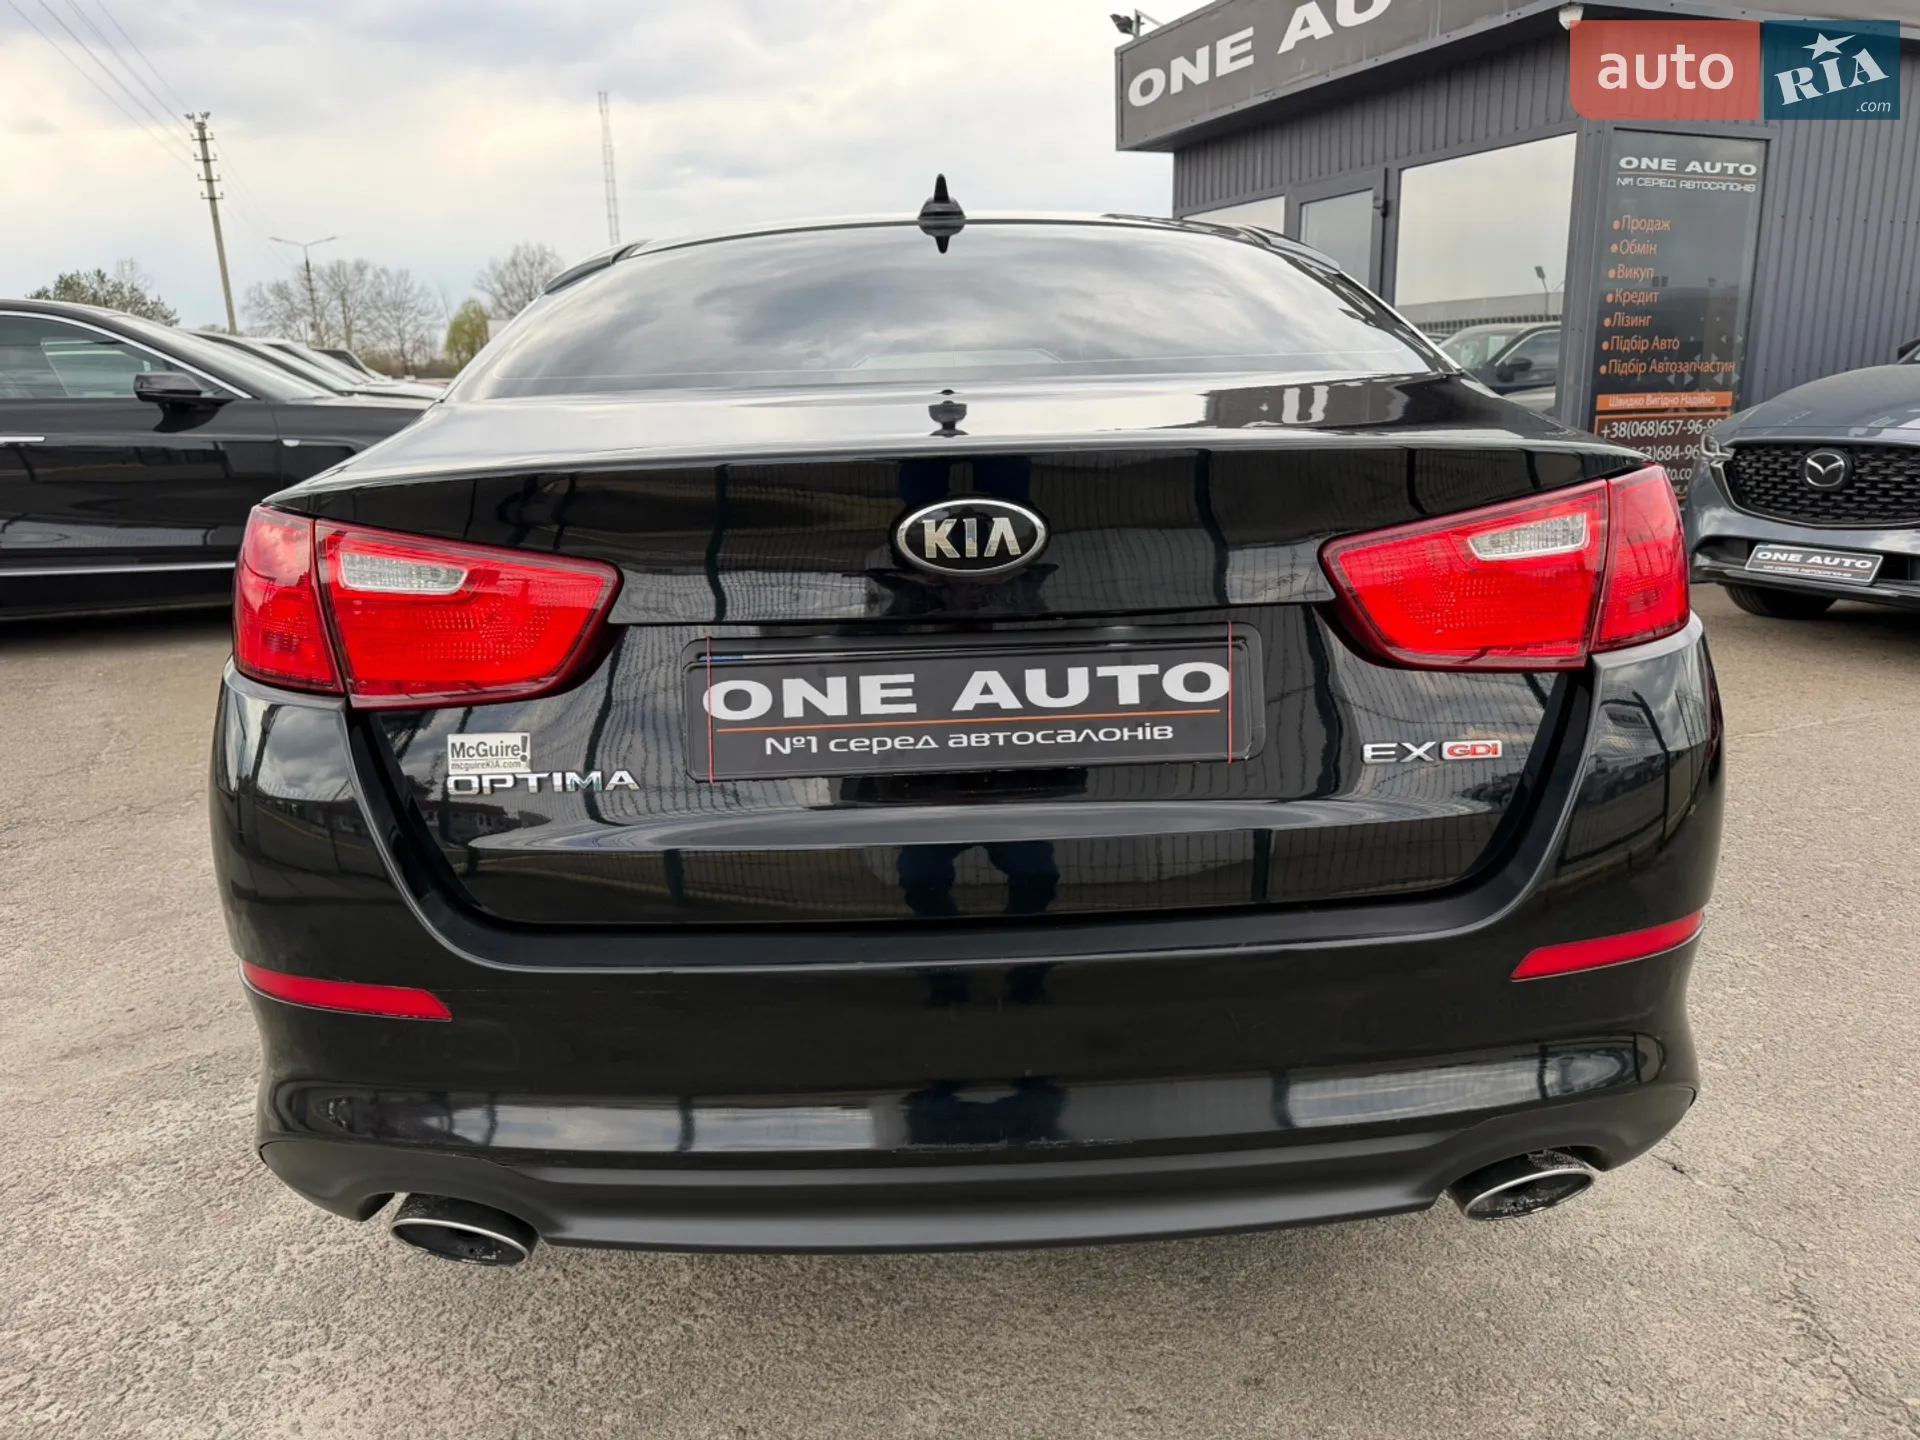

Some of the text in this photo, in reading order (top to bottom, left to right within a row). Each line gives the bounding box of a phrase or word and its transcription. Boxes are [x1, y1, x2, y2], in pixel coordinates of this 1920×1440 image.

[1128, 26, 1255, 107] ONE
[1618, 156, 1758, 176] ONE AUTO
[1621, 214, 1671, 233] Продаж
[1619, 239, 1657, 255] Обмін
[1617, 263, 1654, 283] Викуп
[1614, 287, 1660, 307] Кредит
[1611, 312, 1652, 328] Лізинг
[1610, 335, 1680, 353] Підбір Авто
[1608, 358, 1736, 376] Підбір Автозапчастин
[922, 517, 1022, 559] KIA
[1756, 551, 1872, 569] ONE AUTO
[702, 661, 1230, 721] ONE AUTO
[1363, 741, 1437, 763] EX
[446, 770, 640, 796] OPTIMA
